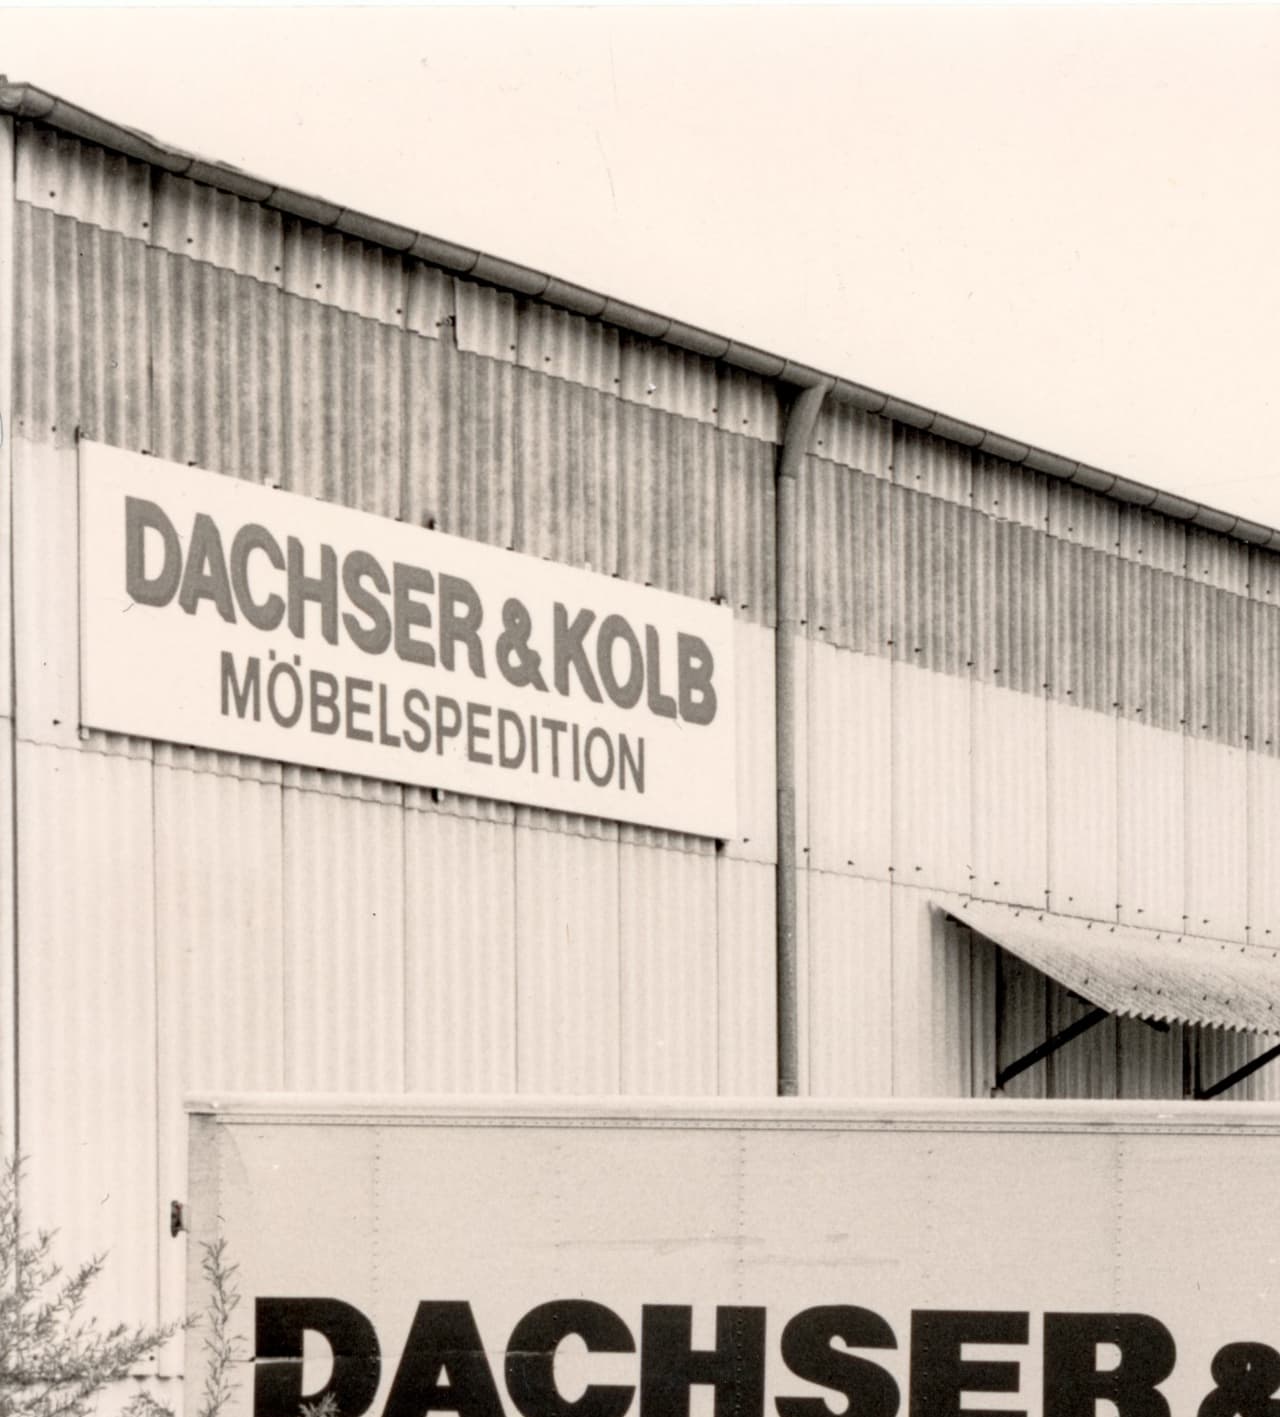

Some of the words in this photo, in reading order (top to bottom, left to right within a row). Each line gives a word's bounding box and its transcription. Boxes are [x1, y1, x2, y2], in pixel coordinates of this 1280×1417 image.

[124, 495, 485, 679] DACHSER
[496, 596, 550, 693] &
[553, 601, 718, 727] KOLB
[220, 649, 646, 795] MÖBELSPEDITION
